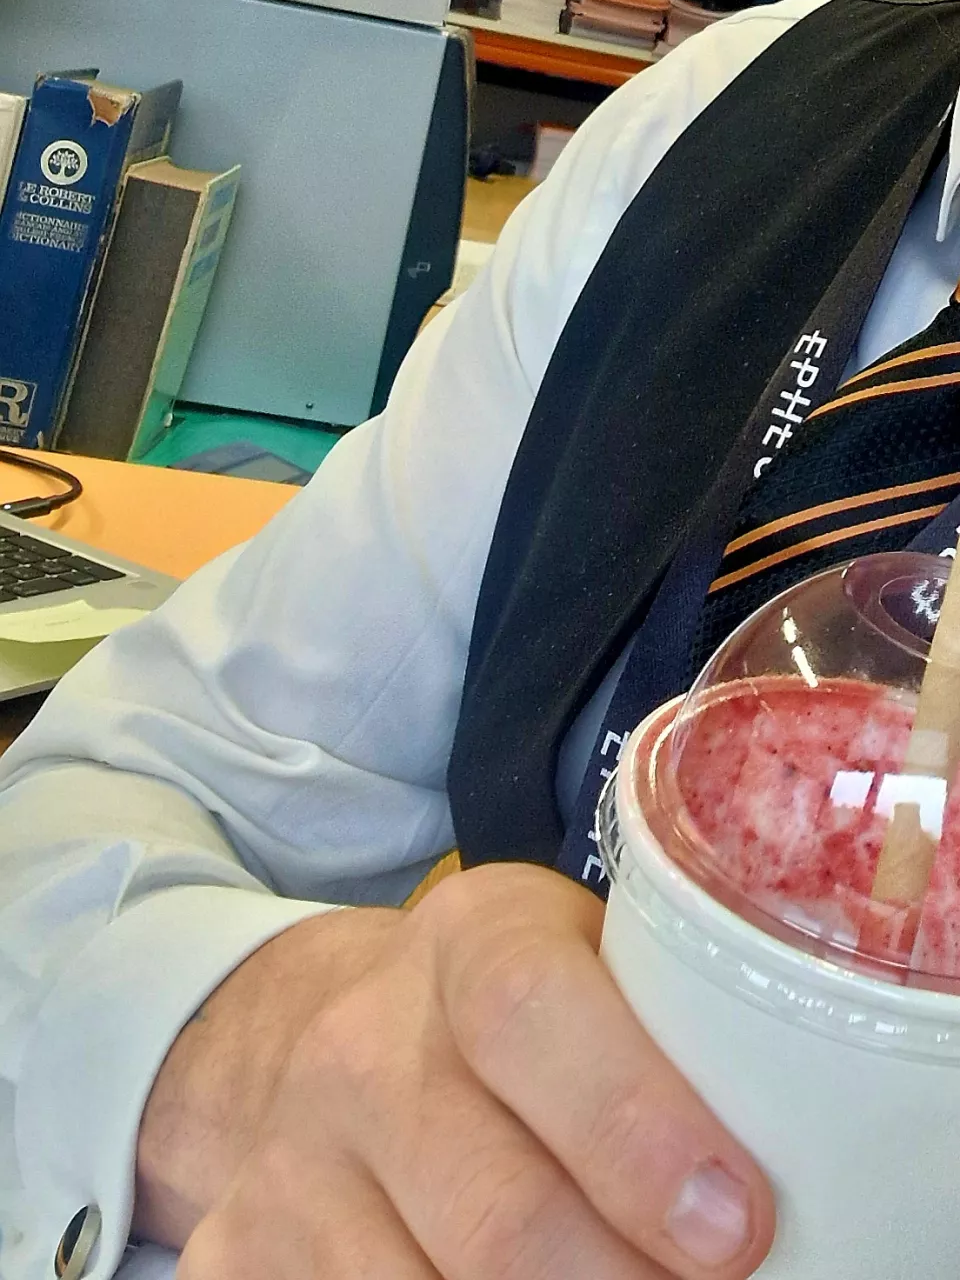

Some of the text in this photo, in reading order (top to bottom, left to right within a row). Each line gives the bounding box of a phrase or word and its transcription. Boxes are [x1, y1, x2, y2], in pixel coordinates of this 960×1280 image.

[29, 193, 93, 214] COLLINS
[39, 185, 96, 205] ROBERT
[10, 230, 84, 253] ICTIONARY
